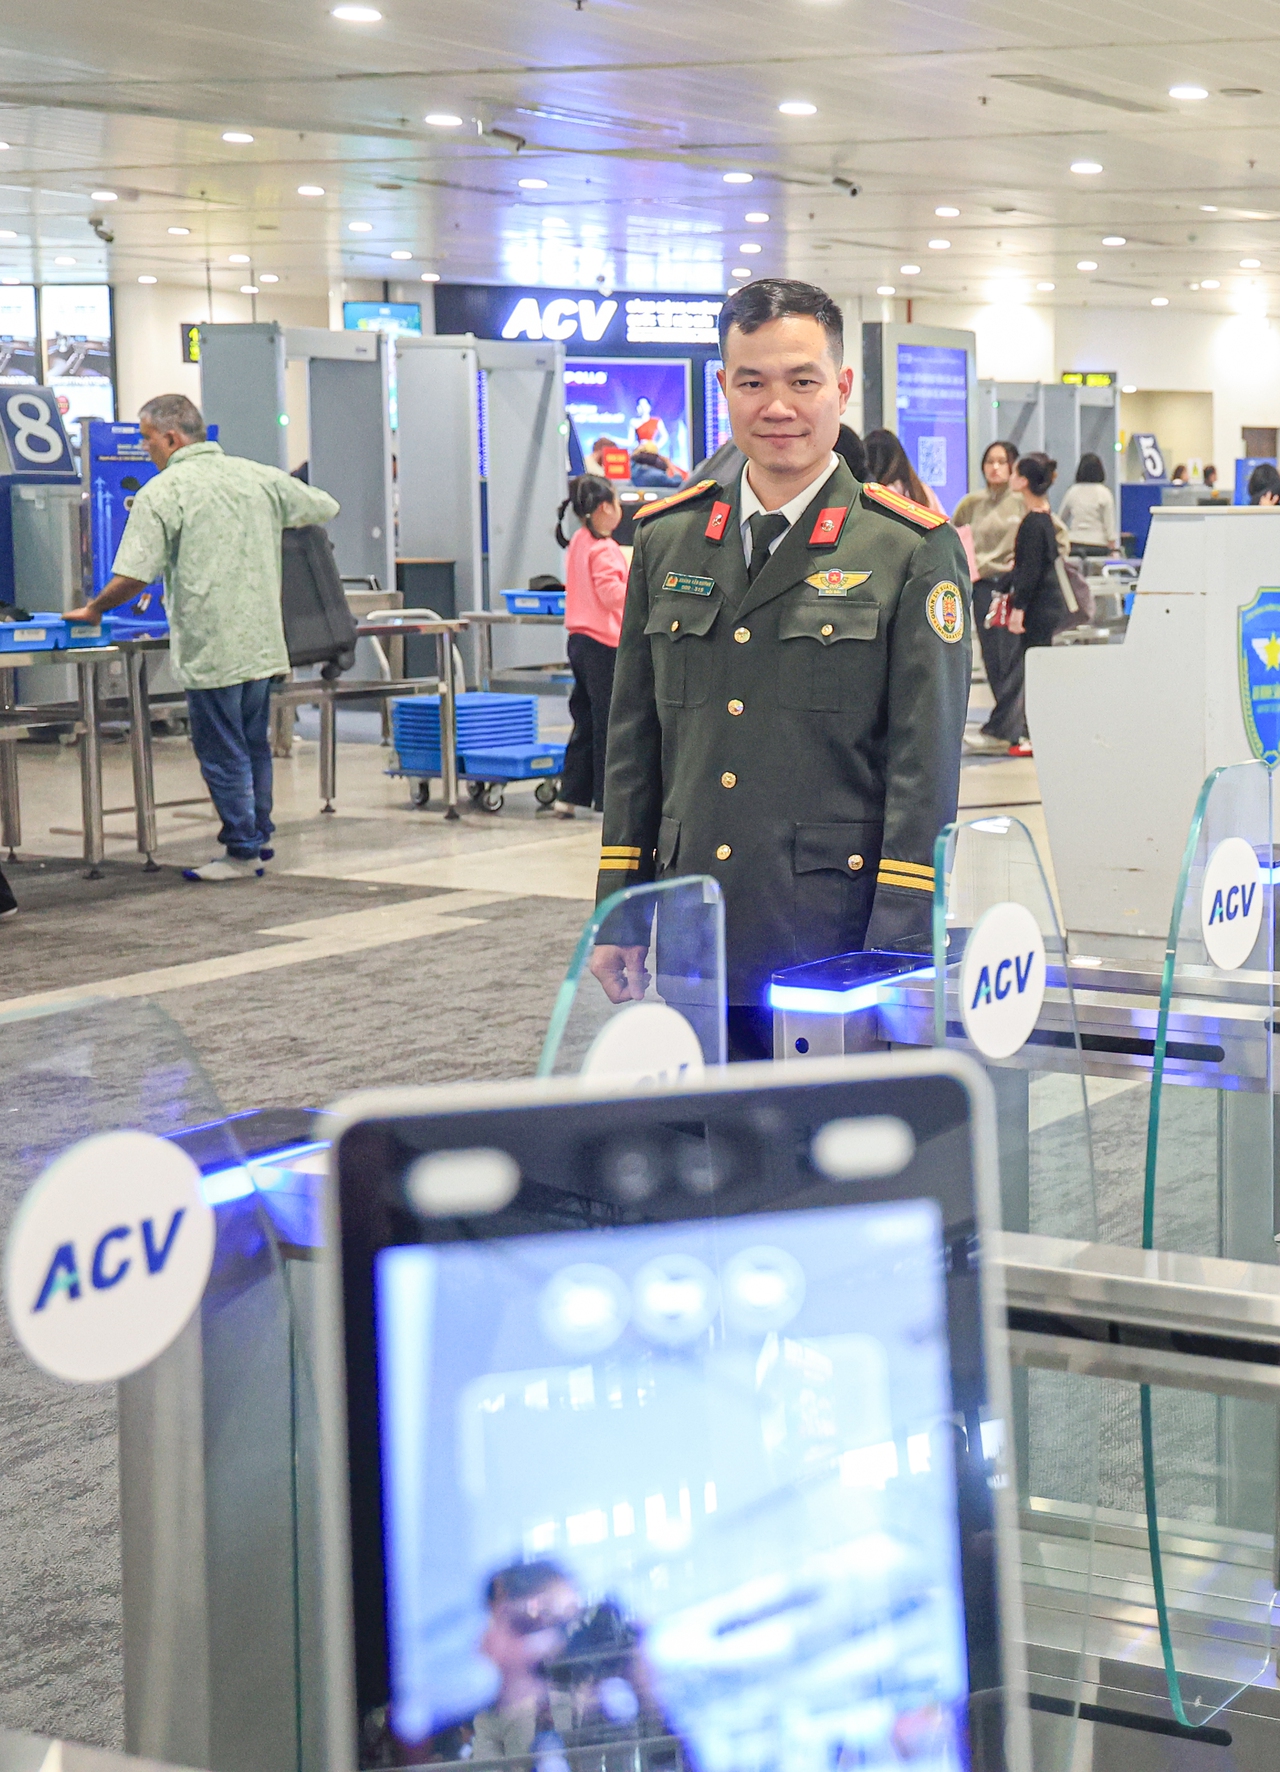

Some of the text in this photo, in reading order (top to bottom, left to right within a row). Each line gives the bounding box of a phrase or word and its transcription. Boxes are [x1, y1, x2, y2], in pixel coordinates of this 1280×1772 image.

[501, 298, 618, 341] ACV
[7, 393, 63, 464] 8
[1139, 436, 1164, 477] 5
[1208, 882, 1256, 925] ACV
[971, 951, 1034, 1010] ACV
[31, 1208, 186, 1314] ACV
